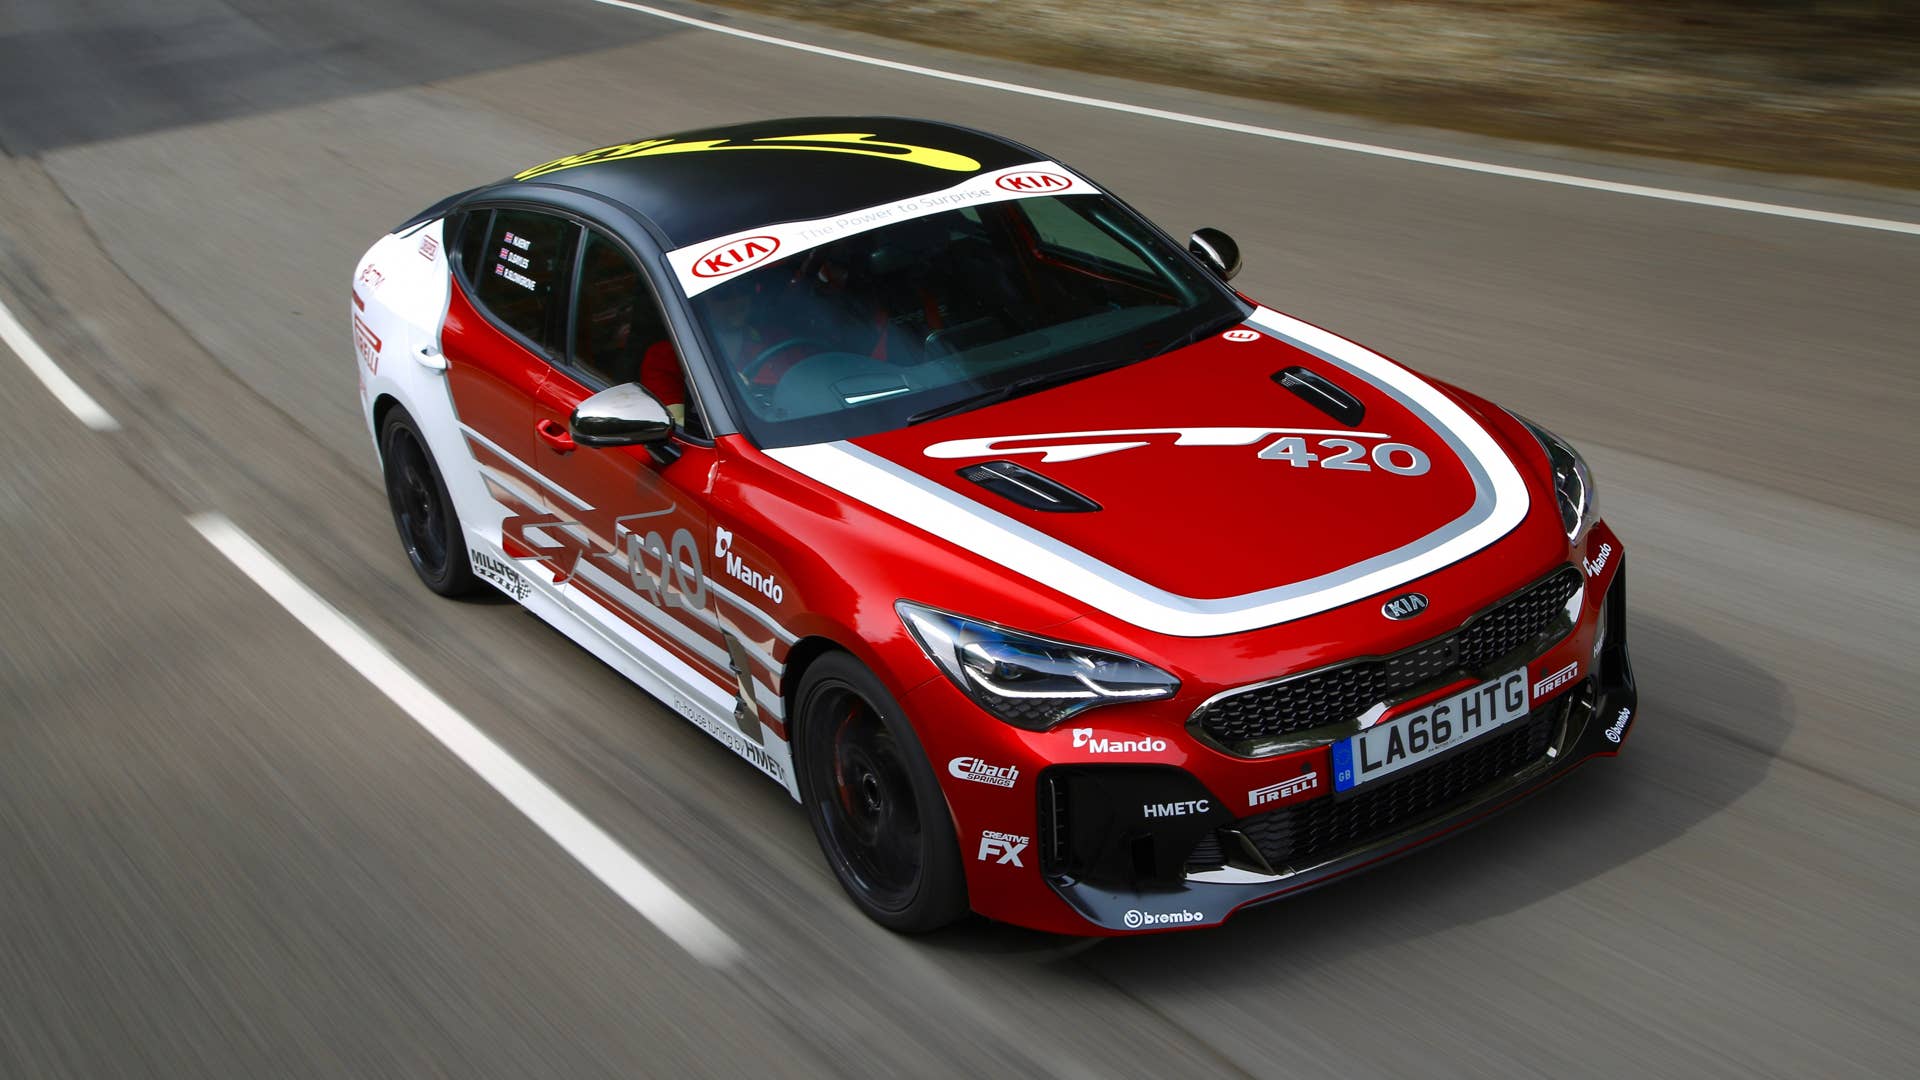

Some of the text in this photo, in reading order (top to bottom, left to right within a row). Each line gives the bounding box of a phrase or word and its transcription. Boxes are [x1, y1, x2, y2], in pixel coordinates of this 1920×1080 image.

[1006, 174, 1062, 189] KIA
[799, 188, 991, 241] The Power to Surprise
[705, 242, 768, 272] KIA
[1257, 437, 1431, 477] 420
[627, 528, 706, 610] 420
[1590, 543, 1611, 576] Mando
[726, 553, 783, 604] Mando
[1388, 595, 1425, 616] KIA
[1534, 662, 1578, 699] PIRELLI
[674, 697, 707, 728] in-house
[708, 721, 733, 748] tuning
[1360, 673, 1524, 774] LA66 HTG
[1089, 737, 1166, 753] Mando
[948, 757, 1019, 780] Eibach
[967, 773, 1010, 786] SPRINGS
[1339, 769, 1351, 782] GB
[1248, 772, 1318, 806] PIRELLI
[1143, 800, 1209, 818] HMETC
[978, 837, 1028, 867] FX
[982, 830, 1029, 844] CREATIVE
[1144, 910, 1203, 925] brembo
